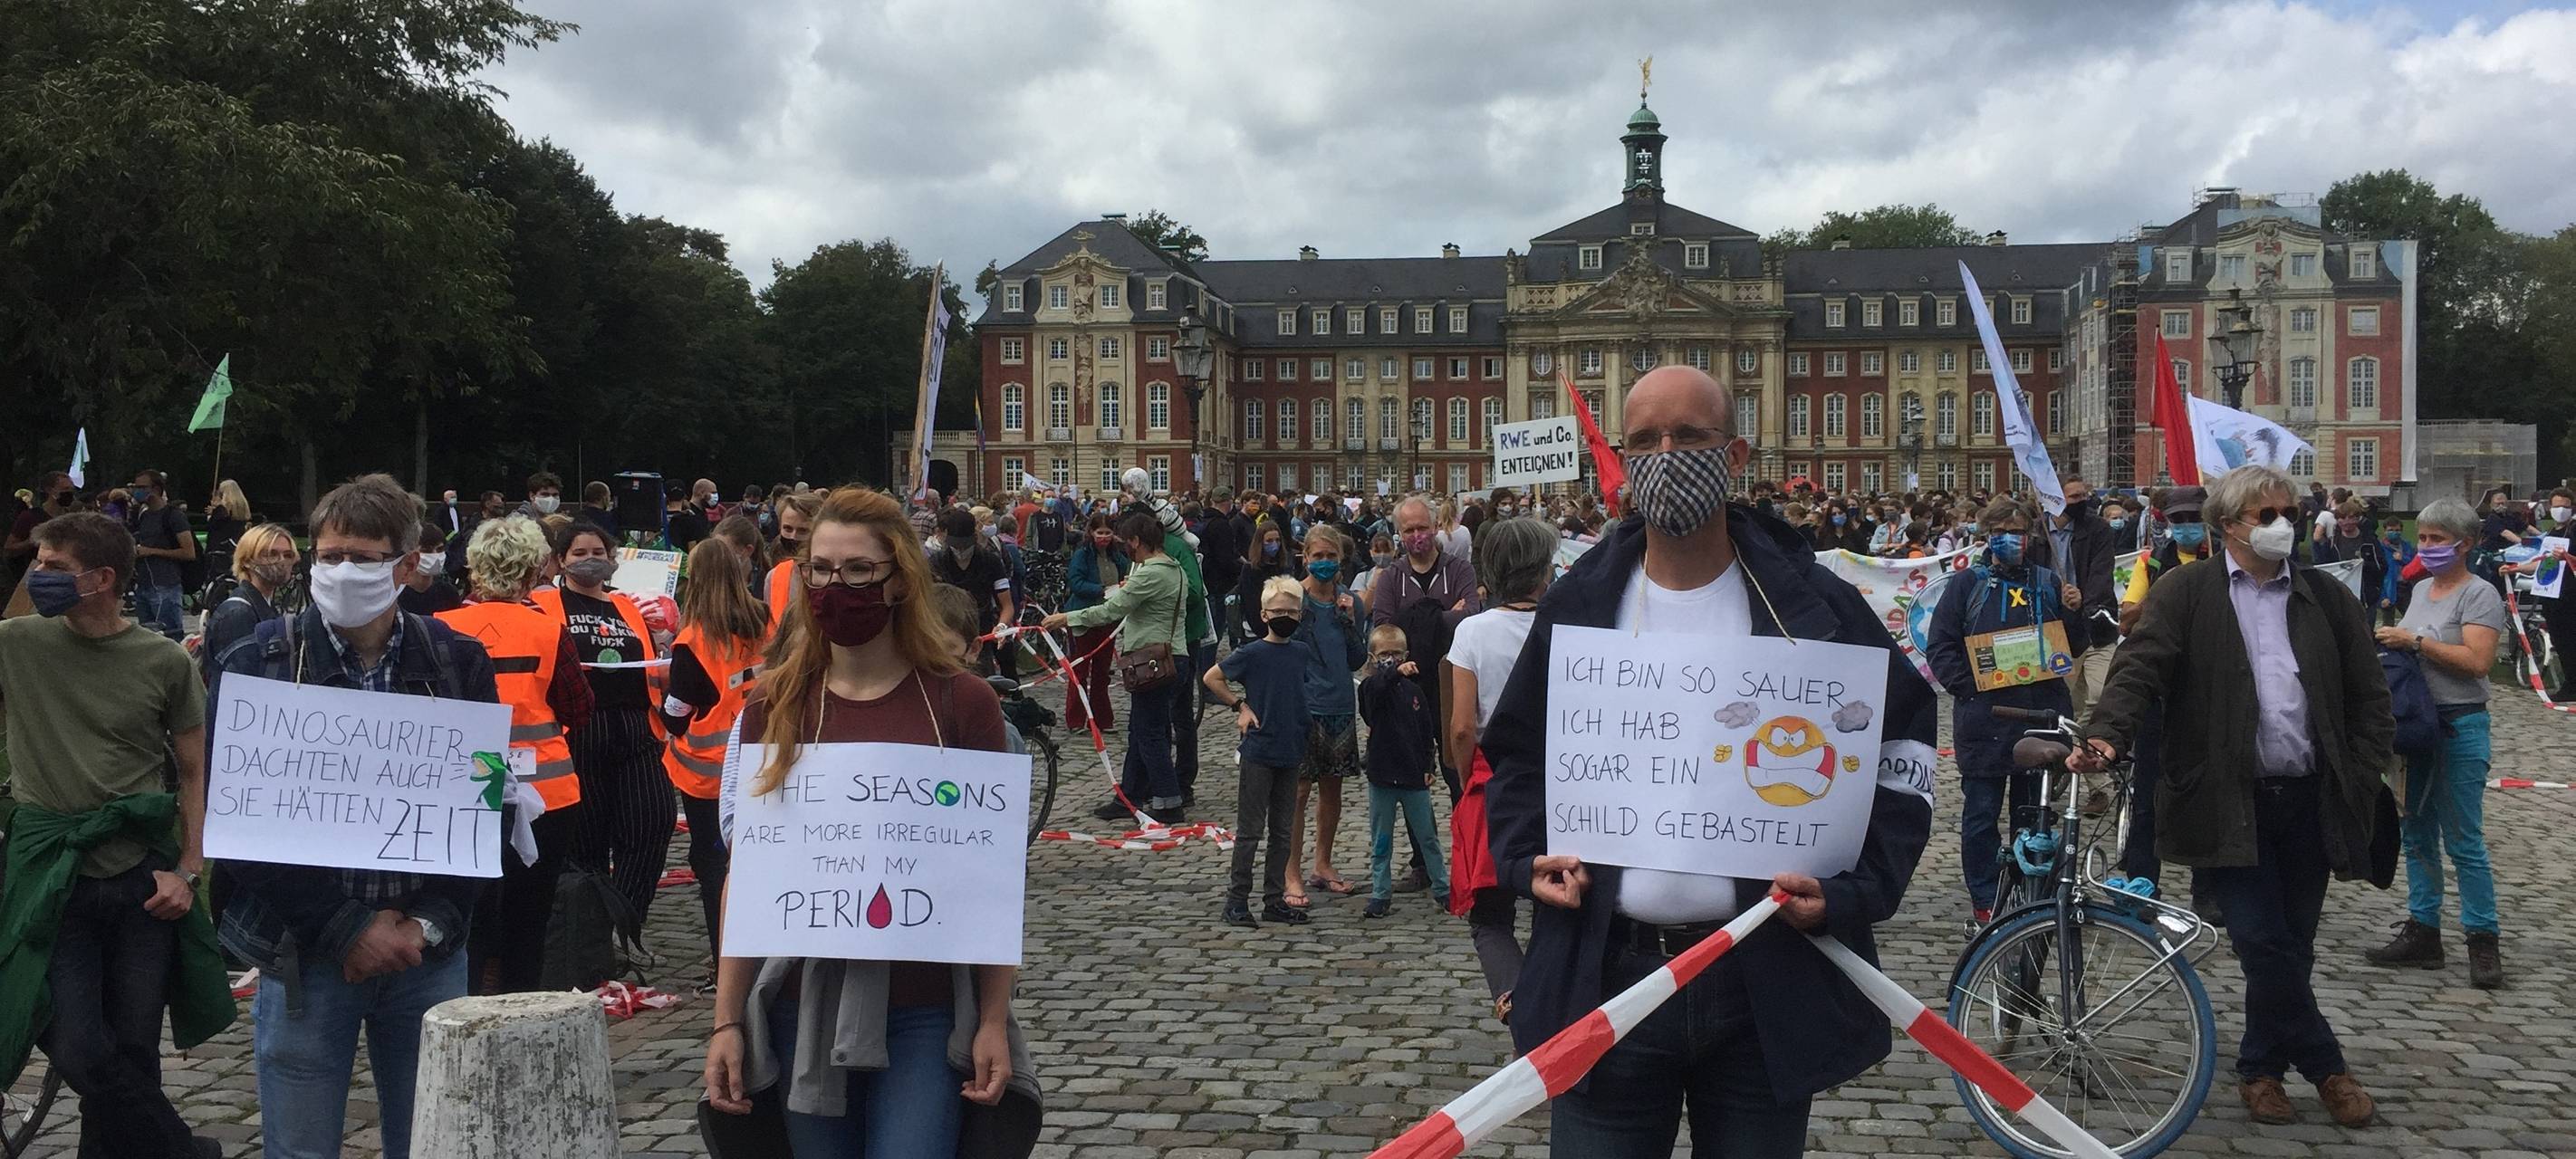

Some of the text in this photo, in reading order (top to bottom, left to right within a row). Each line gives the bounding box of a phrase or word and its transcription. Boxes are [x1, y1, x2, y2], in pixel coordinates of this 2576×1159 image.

[1500, 426, 1574, 451] RWE und Co.
[566, 625, 589, 633] OU
[569, 614, 602, 625] FUCK
[590, 635, 625, 647] FUCK
[1564, 656, 1848, 709] ICH BIN SO SAUER
[226, 699, 466, 762] DINOSAURIER
[1562, 708, 1680, 741] ICH HAB
[220, 744, 443, 790] DACHTEN AUCH
[1555, 752, 1700, 785] SOGAR EIN
[846, 774, 1007, 812] SEASONS
[214, 785, 503, 869] SIE HÄTTEN ZEIT
[740, 822, 995, 847] ARE MORE IRREGULAR
[1553, 802, 1830, 848] SCHILD GEBASTELT
[812, 855, 918, 876] THAN MY
